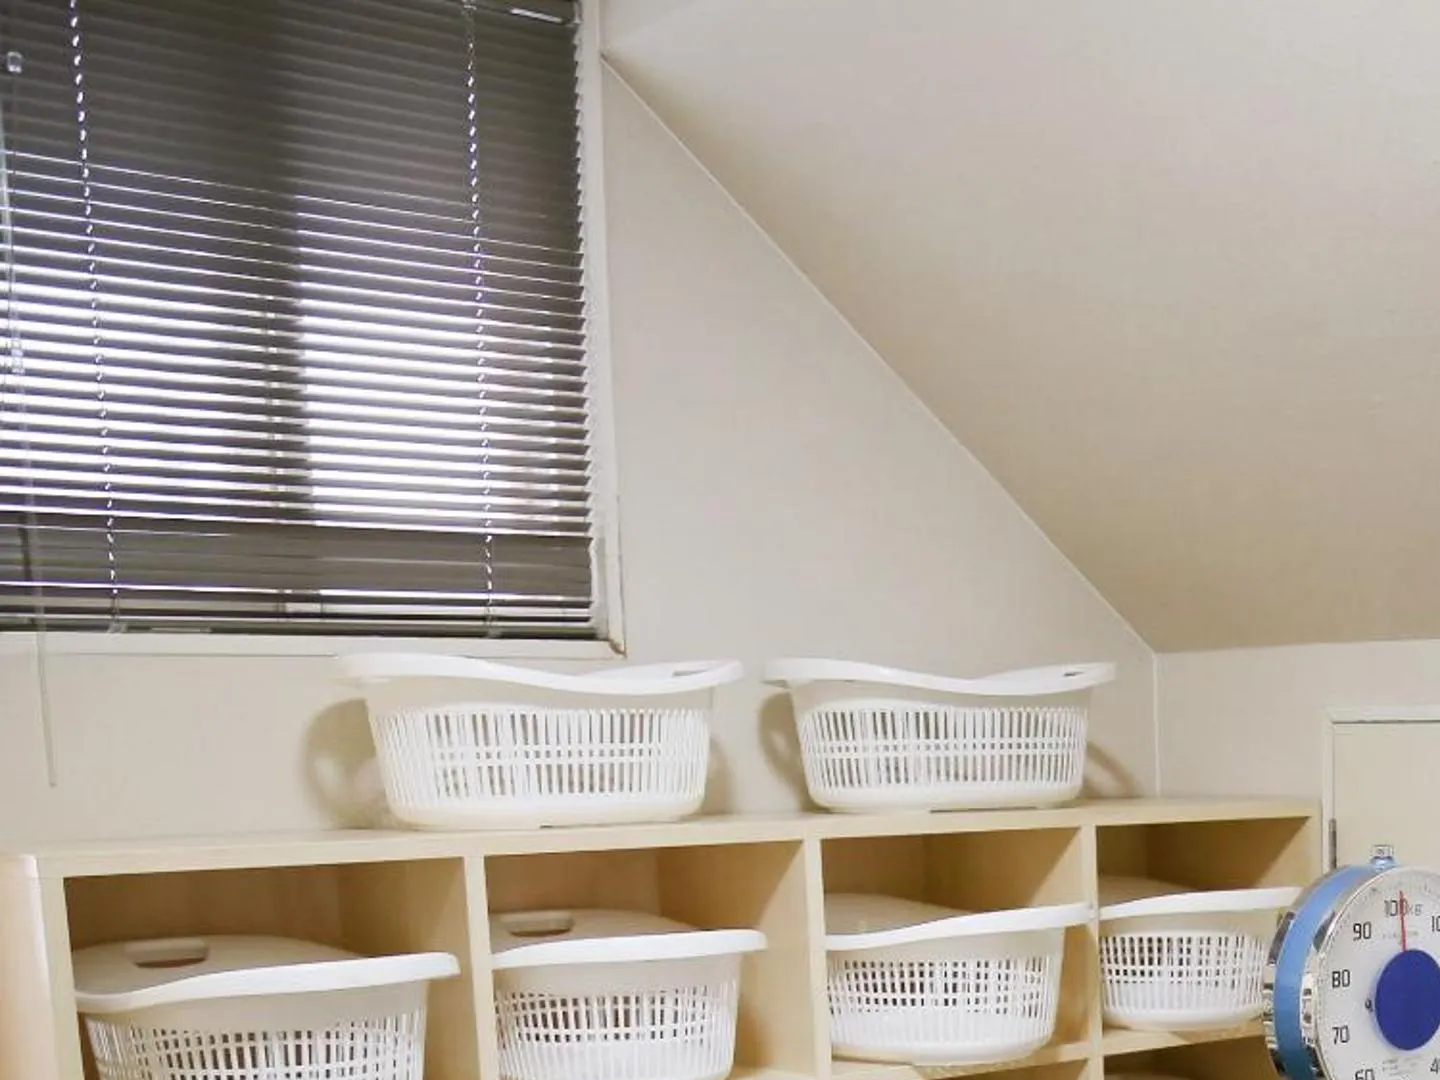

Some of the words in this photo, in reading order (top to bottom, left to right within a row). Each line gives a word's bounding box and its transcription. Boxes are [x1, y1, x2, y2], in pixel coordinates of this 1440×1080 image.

[1353, 924, 1372, 941] 90
[1332, 970, 1351, 988] 80
[1332, 1025, 1350, 1044] 70
